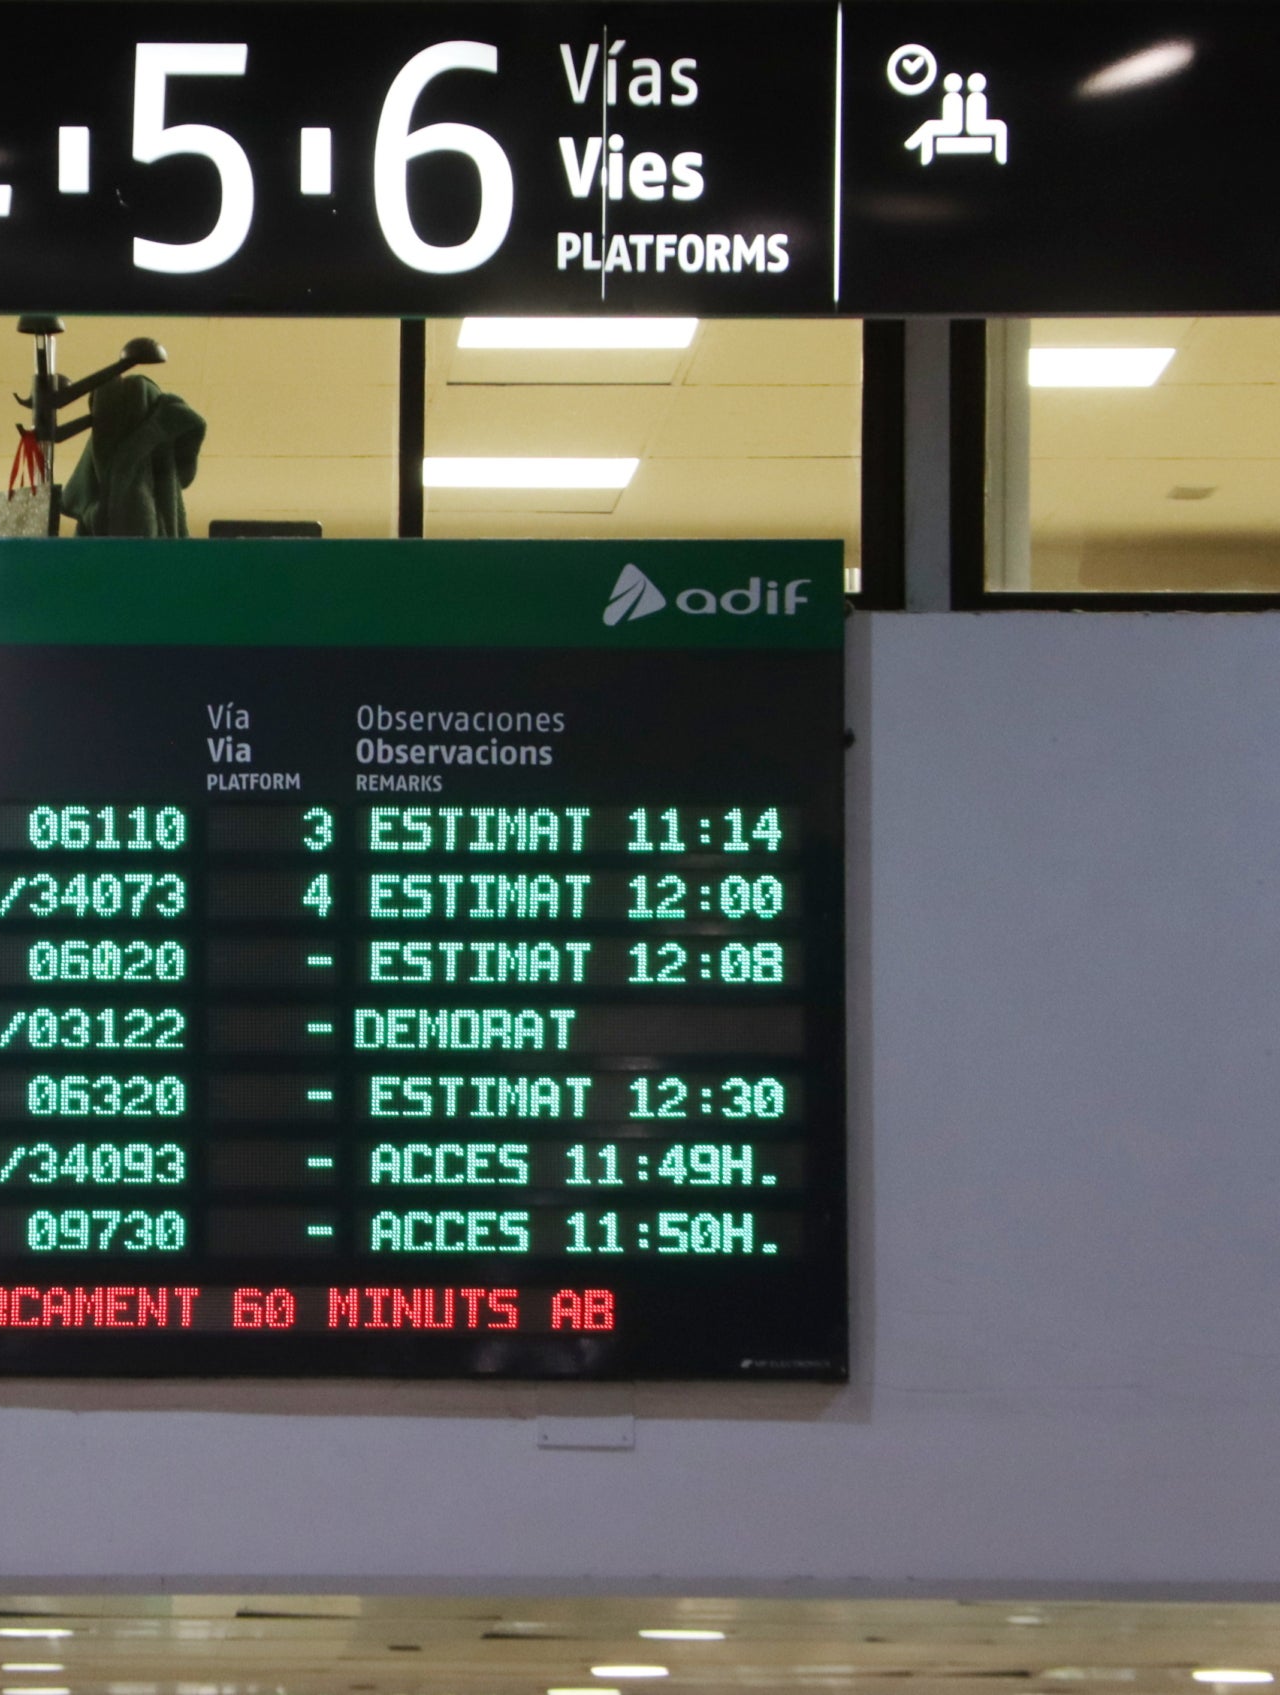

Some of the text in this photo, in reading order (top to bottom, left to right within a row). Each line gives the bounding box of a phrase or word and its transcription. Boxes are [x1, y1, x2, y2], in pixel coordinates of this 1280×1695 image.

[560, 40, 698, 106] Vías
[559, 134, 704, 200] Vies
[557, 232, 789, 273] PLATFORMS
[676, 577, 810, 614] adif
[208, 702, 249, 729] Vía
[357, 705, 564, 732] Observaciones
[207, 736, 251, 762] Via
[357, 738, 552, 765] Observacions
[207, 773, 300, 790] PLATFORM
[357, 774, 442, 792] REMARKS
[29, 806, 185, 850] 06110
[304, 807, 332, 850] 3
[371, 807, 590, 851] ESTIMAT
[628, 808, 782, 851] 11:14
[303, 874, 332, 917] 4
[371, 874, 590, 918] ESTIMAT
[628, 875, 783, 918] 12:00
[29, 940, 185, 981] 06020
[371, 942, 591, 982] ESTIMAT
[629, 943, 783, 983] 12:08
[355, 1009, 575, 1049] DEMORAT
[28, 1075, 185, 1115] 06320
[371, 1076, 591, 1117] ESTIMAT
[629, 1077, 784, 1118] 12:30
[371, 1144, 528, 1184] ACCES
[566, 1144, 776, 1185] 11:49H.
[28, 1210, 185, 1250] 09730
[372, 1211, 529, 1252] ACCES
[566, 1212, 777, 1253] 11:50H.
[233, 1288, 296, 1328] 60
[329, 1288, 518, 1328] MINUTS
[552, 1289, 614, 1330] AB
